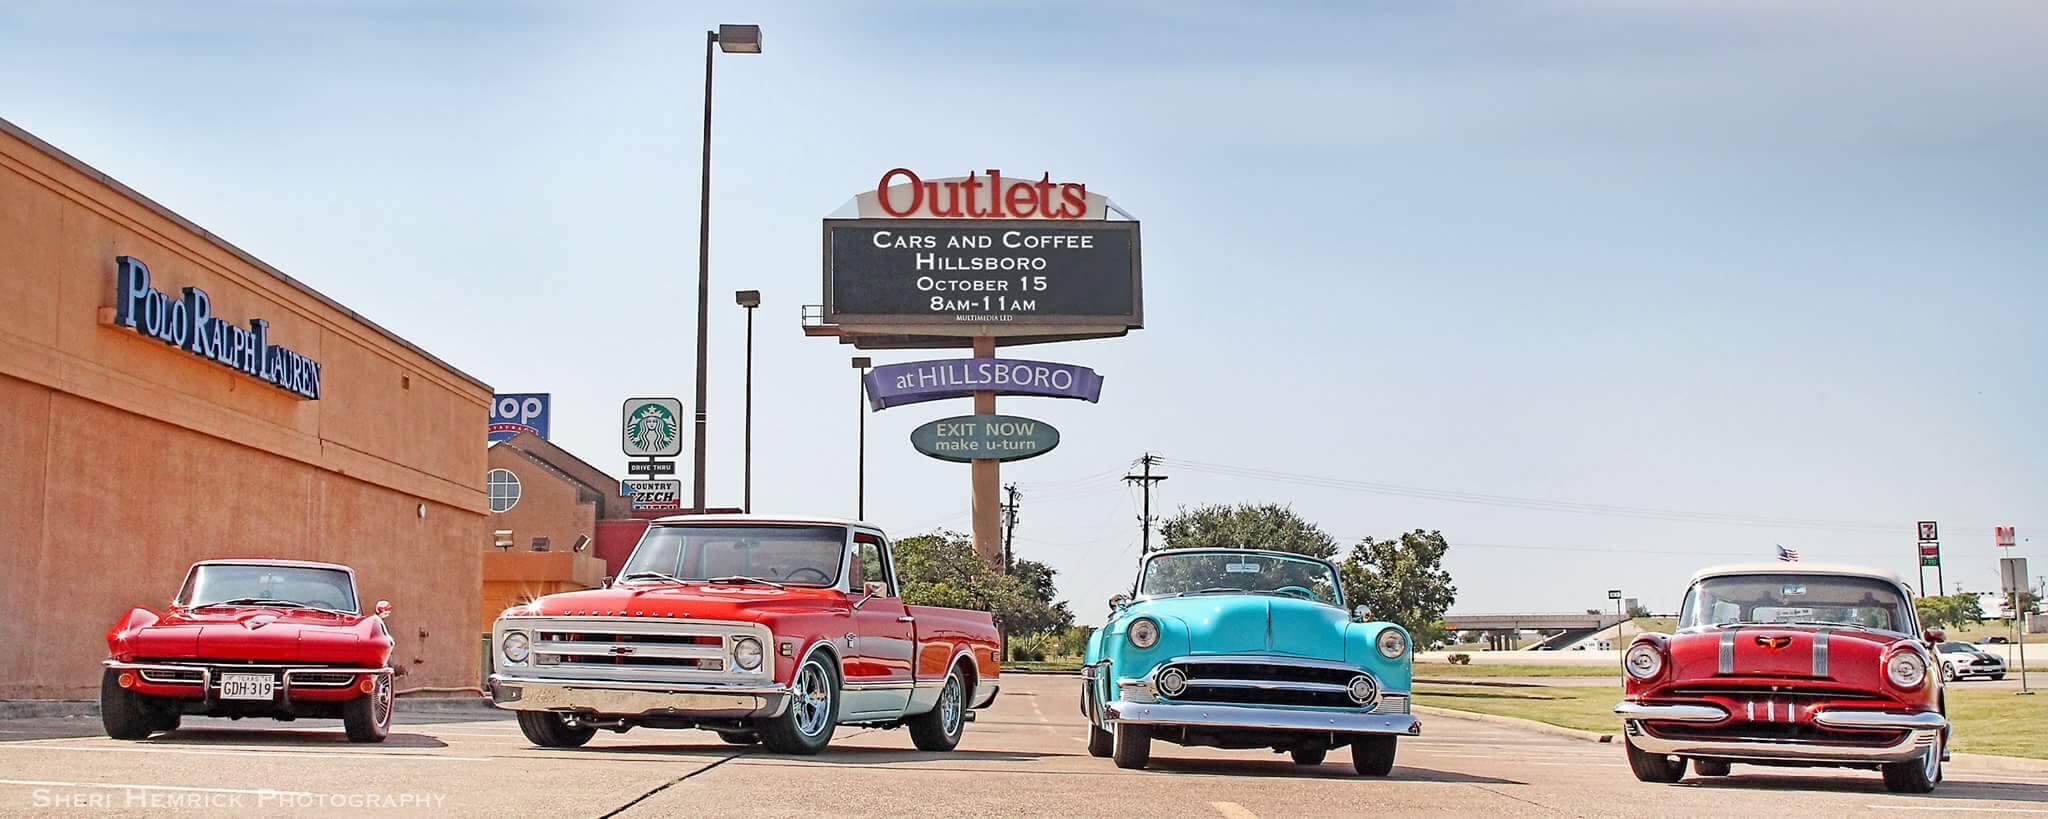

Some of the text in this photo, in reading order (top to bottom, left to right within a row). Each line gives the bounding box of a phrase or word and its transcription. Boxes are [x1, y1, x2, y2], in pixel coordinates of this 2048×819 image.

[877, 168, 1087, 219] Outlets
[1020, 276, 1048, 292] 15
[896, 363, 1073, 390] at HILLSBORO
[936, 422, 1035, 437] EXIT NOW
[936, 439, 1036, 451] make u-turn
